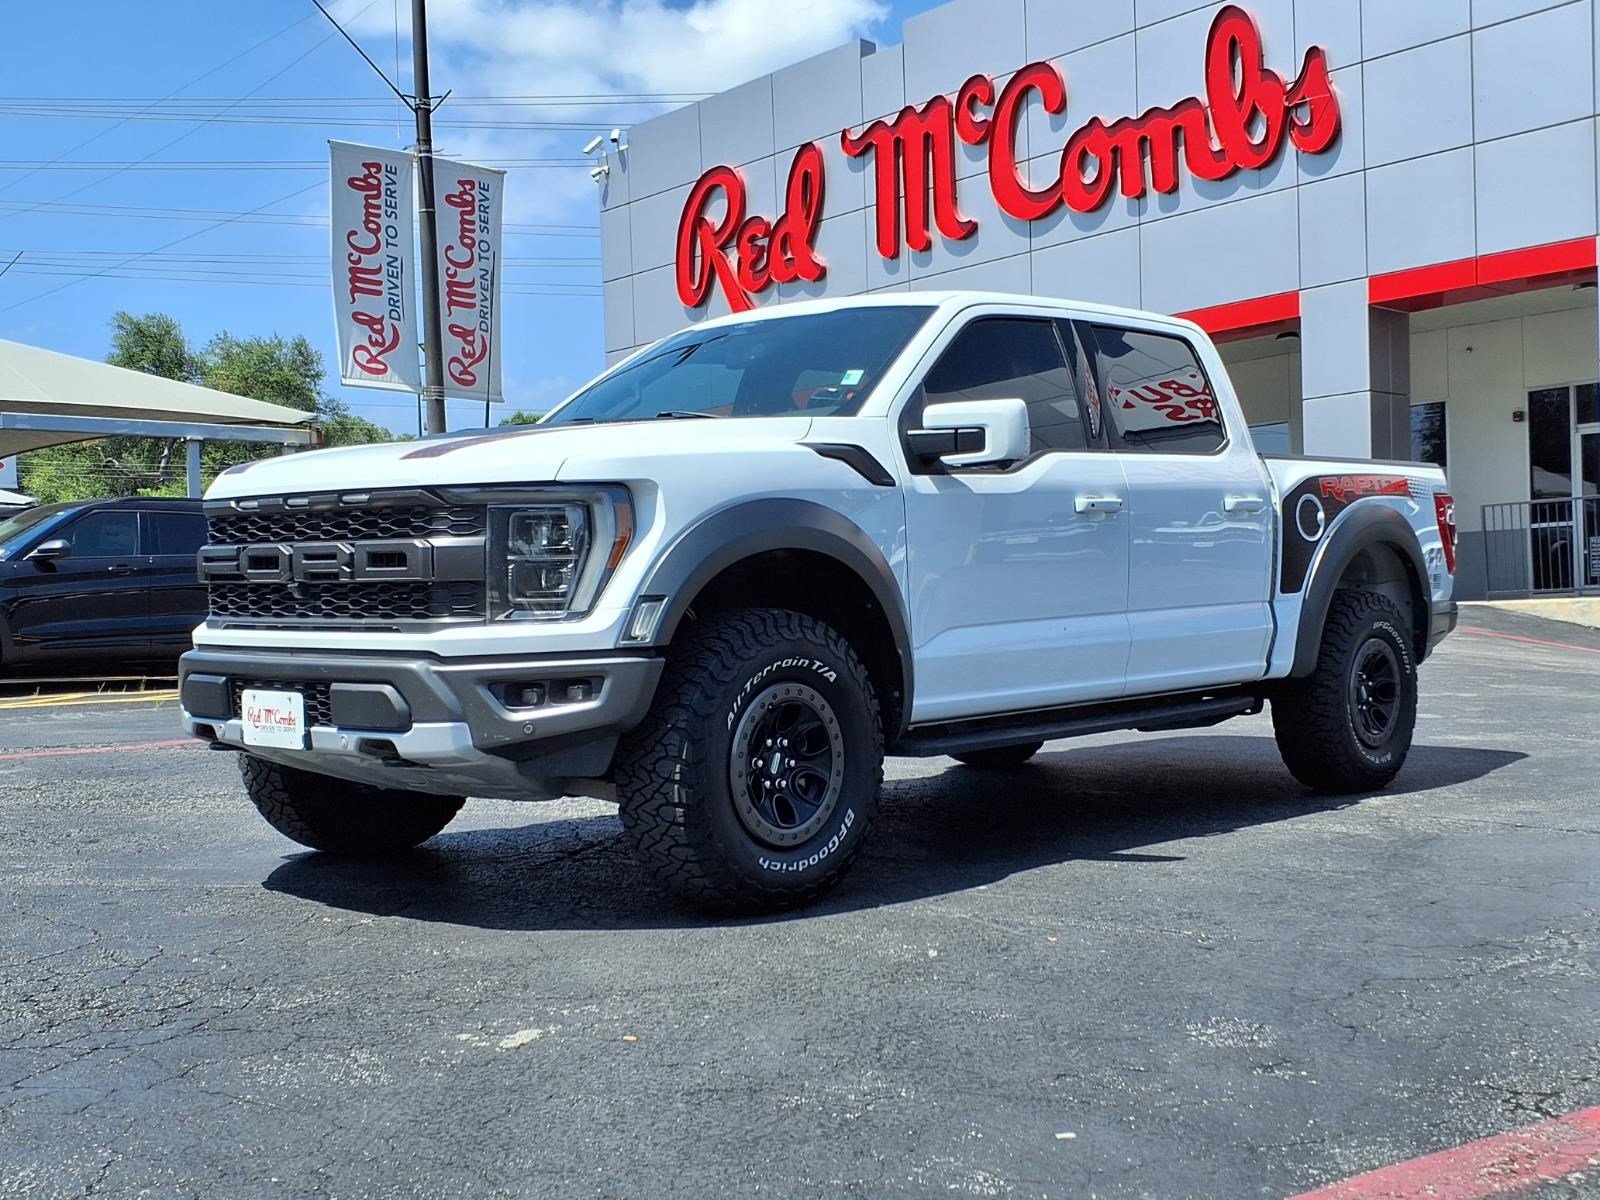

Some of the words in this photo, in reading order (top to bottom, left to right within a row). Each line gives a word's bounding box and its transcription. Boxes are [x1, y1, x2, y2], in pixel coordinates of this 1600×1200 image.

[676, 142, 826, 313] Red
[841, 5, 1341, 260] McCombs
[384, 164, 398, 221] SERVE
[478, 181, 490, 233] SERVE
[347, 162, 383, 304] McCombs
[385, 225, 398, 251] TO
[444, 179, 477, 316] McCombs
[478, 239, 490, 262] TO
[388, 256, 401, 321] DRIVEN
[478, 269, 490, 333] DRIVEN
[352, 311, 400, 376] Red
[448, 324, 488, 387] Red
[1319, 476, 1408, 503] RAPT
[197, 538, 432, 585] FORD
[759, 807, 855, 873] BFGoodrich
